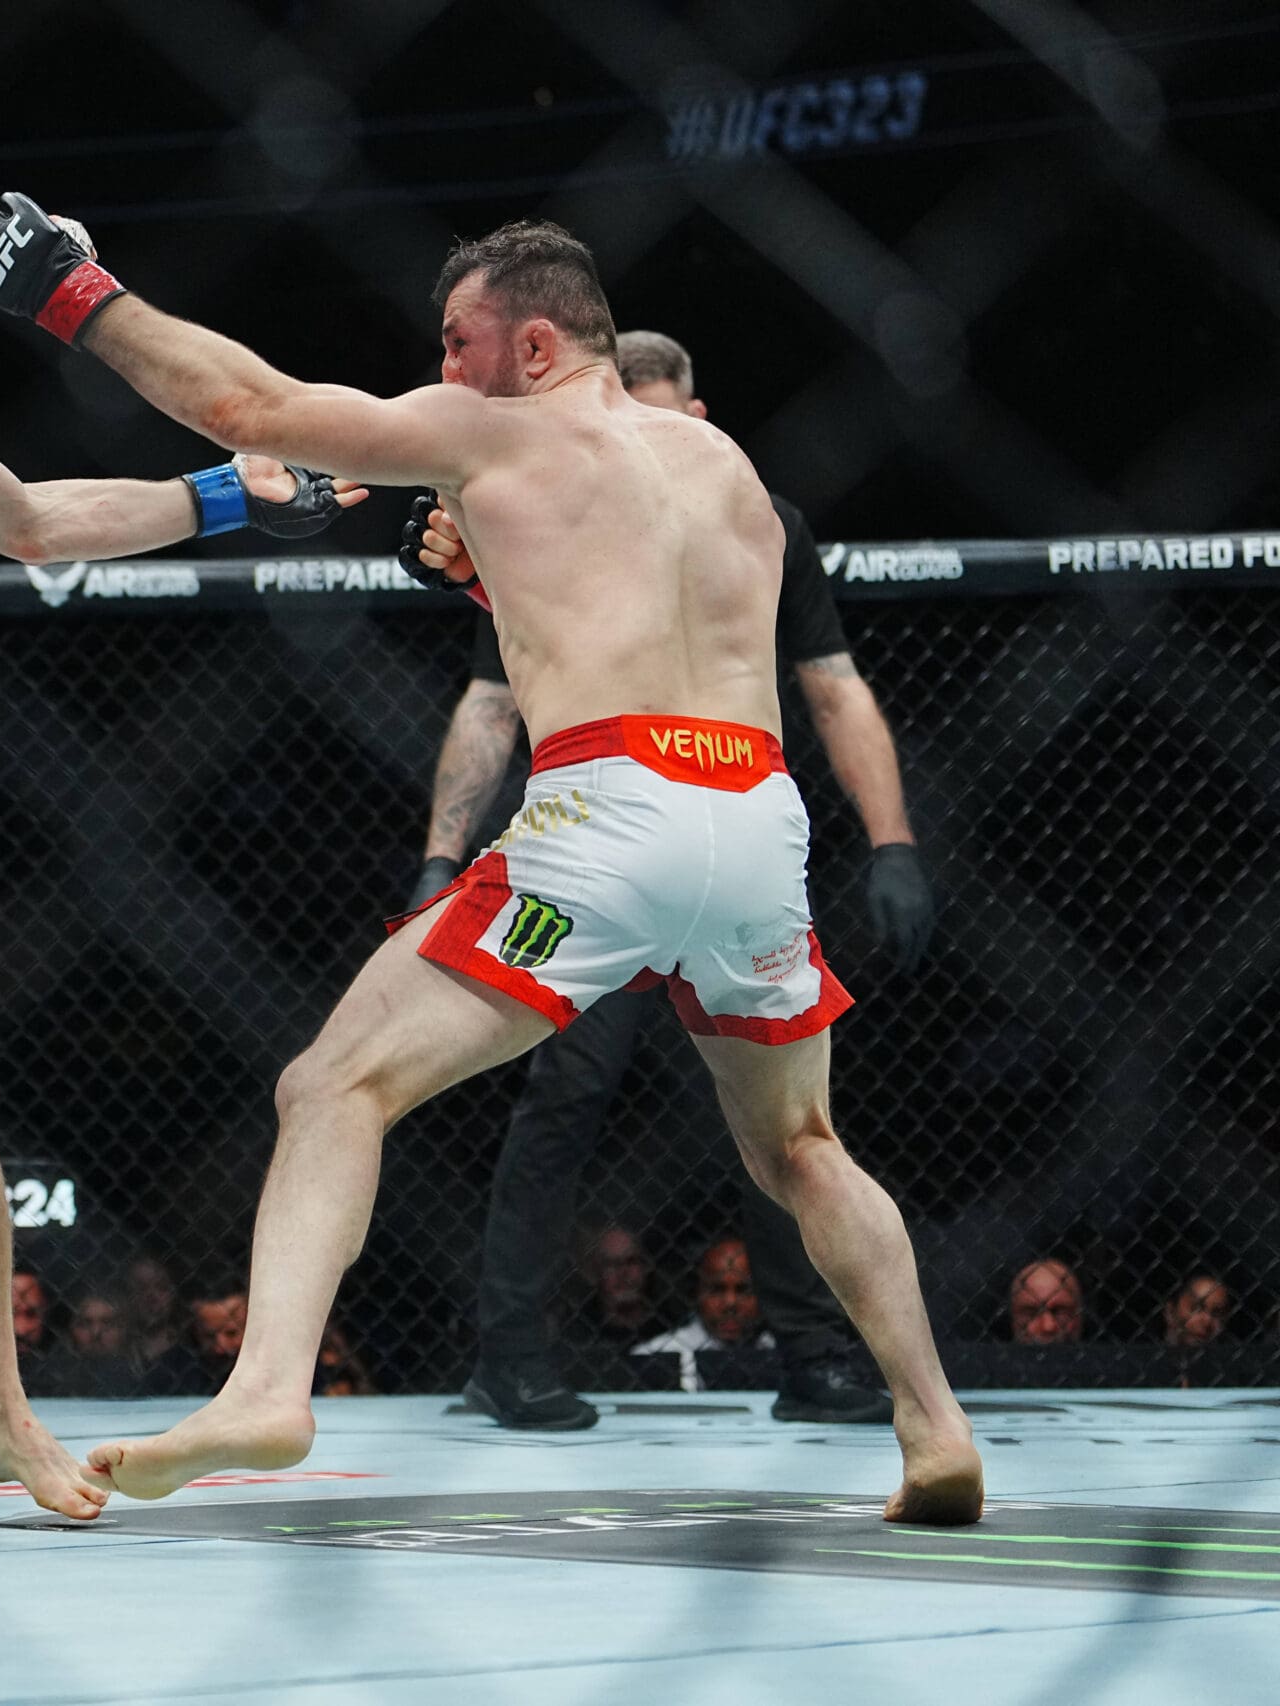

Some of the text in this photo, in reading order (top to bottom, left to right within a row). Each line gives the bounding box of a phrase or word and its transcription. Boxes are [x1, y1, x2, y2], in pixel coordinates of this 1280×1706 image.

[844, 550, 898, 582] AIR
[1048, 538, 1235, 574] PREPARED
[83, 566, 137, 598] AIR
[255, 560, 428, 593] PREPARE
[650, 727, 754, 773] VENUM
